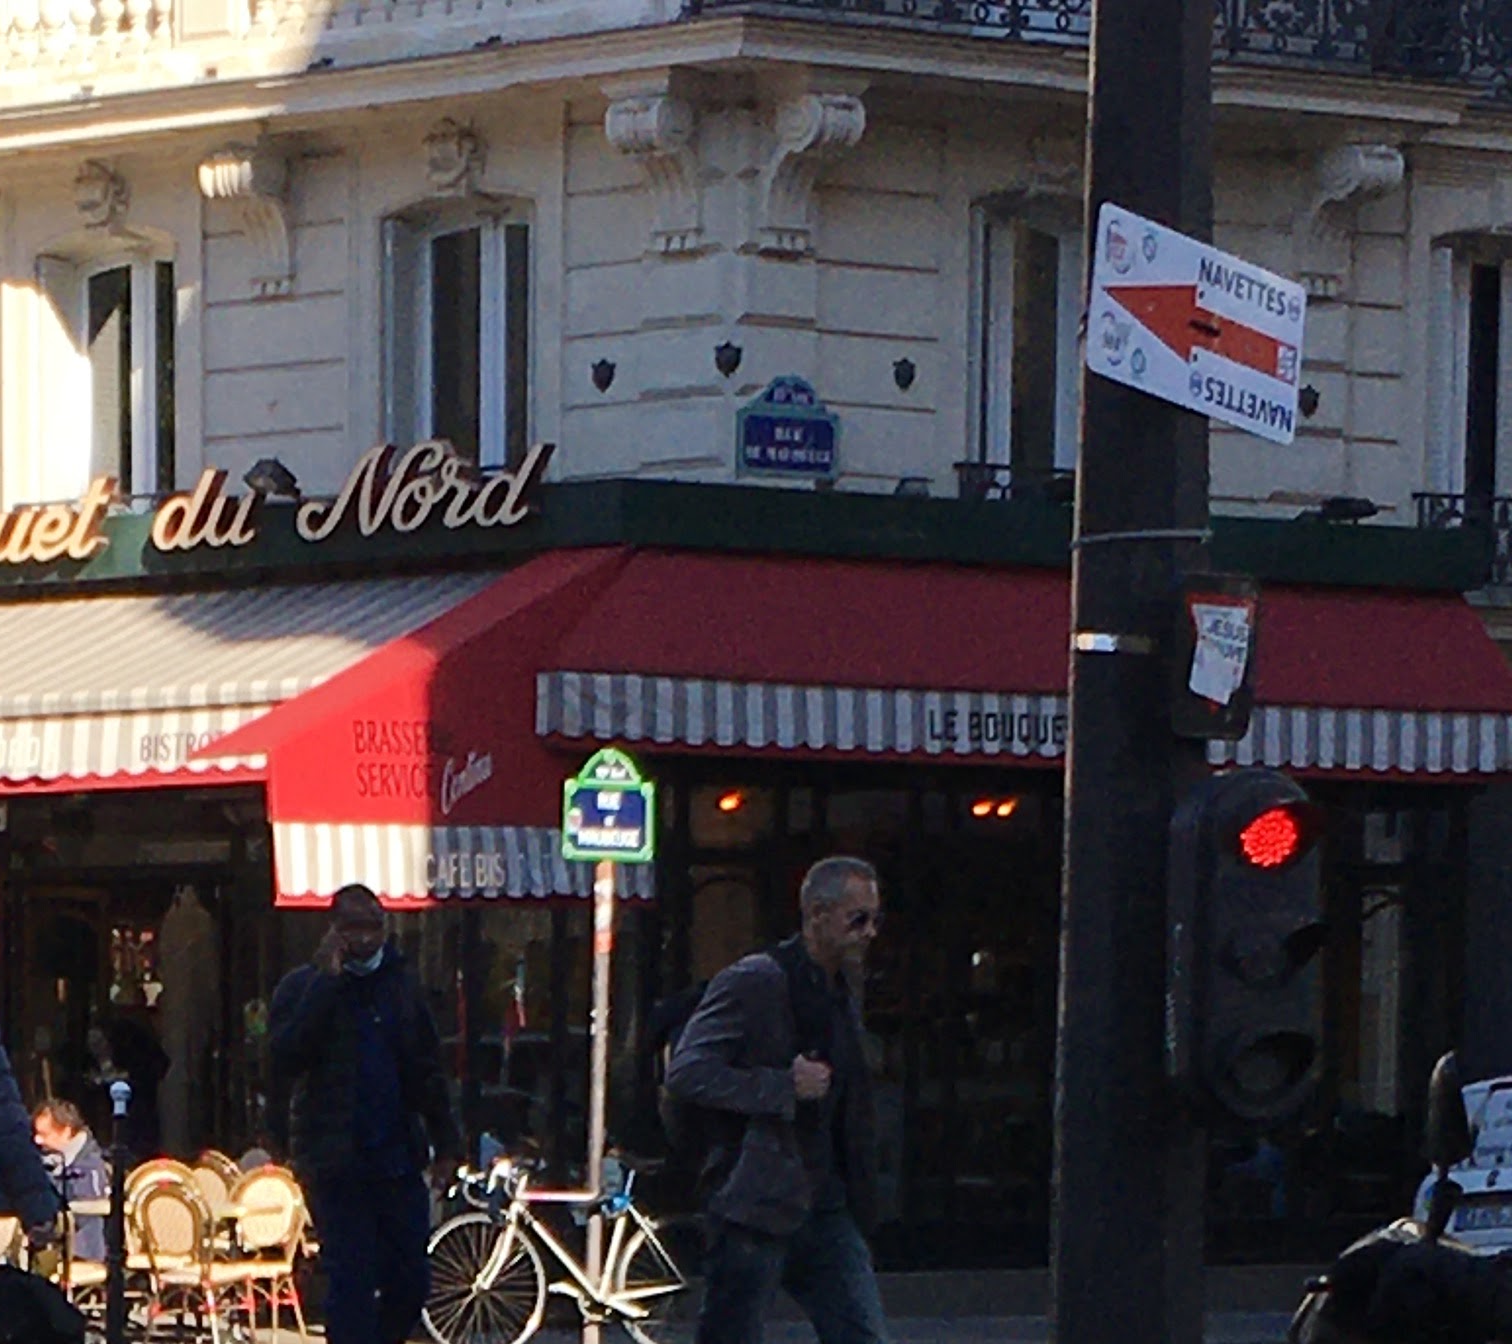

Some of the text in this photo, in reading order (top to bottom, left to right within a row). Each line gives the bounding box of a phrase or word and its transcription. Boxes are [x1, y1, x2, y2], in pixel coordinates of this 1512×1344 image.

[1197, 256, 1287, 317] NAVETTES
[1203, 376, 1294, 433] NAVETTES
[152, 467, 260, 551] du
[295, 437, 556, 542] Nord
[929, 709, 1067, 747] LE BOUQUE
